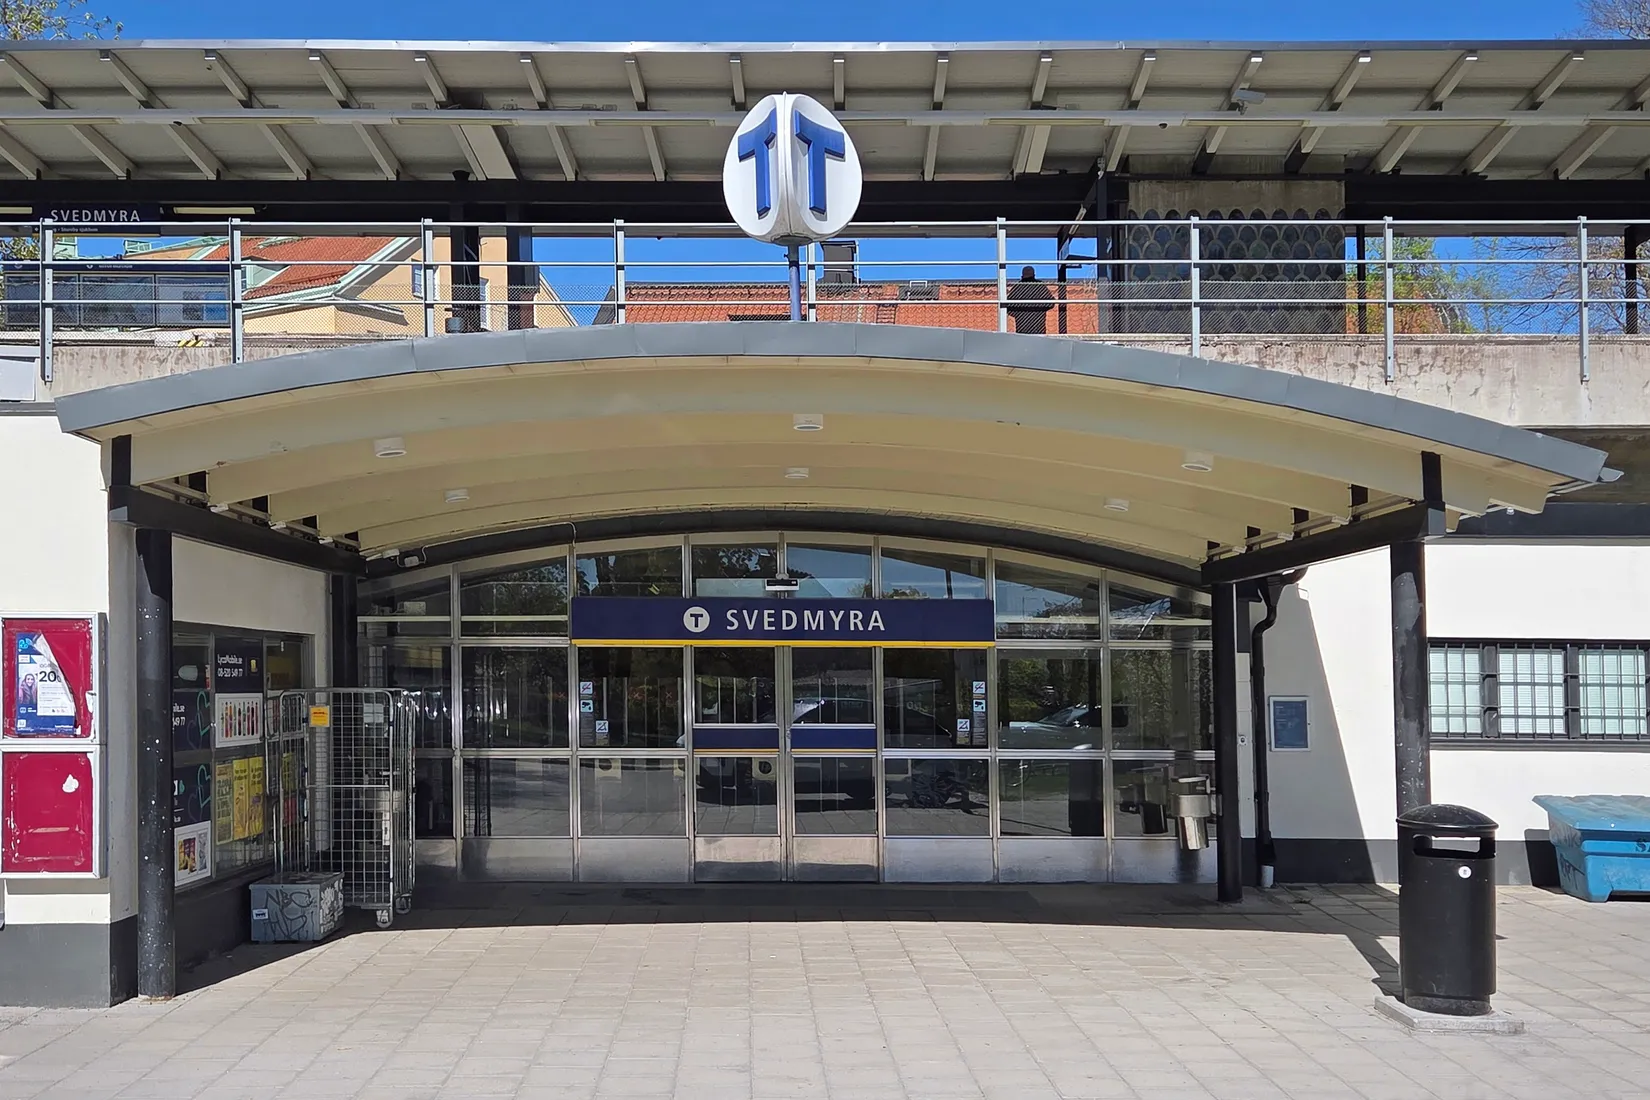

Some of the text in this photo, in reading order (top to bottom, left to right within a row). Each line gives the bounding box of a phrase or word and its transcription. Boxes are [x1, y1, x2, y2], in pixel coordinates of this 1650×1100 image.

[738, 106, 776, 216] T
[795, 109, 845, 215] T
[50, 209, 141, 222] SVEDMYRA
[726, 609, 886, 631] SVEDMYRA
